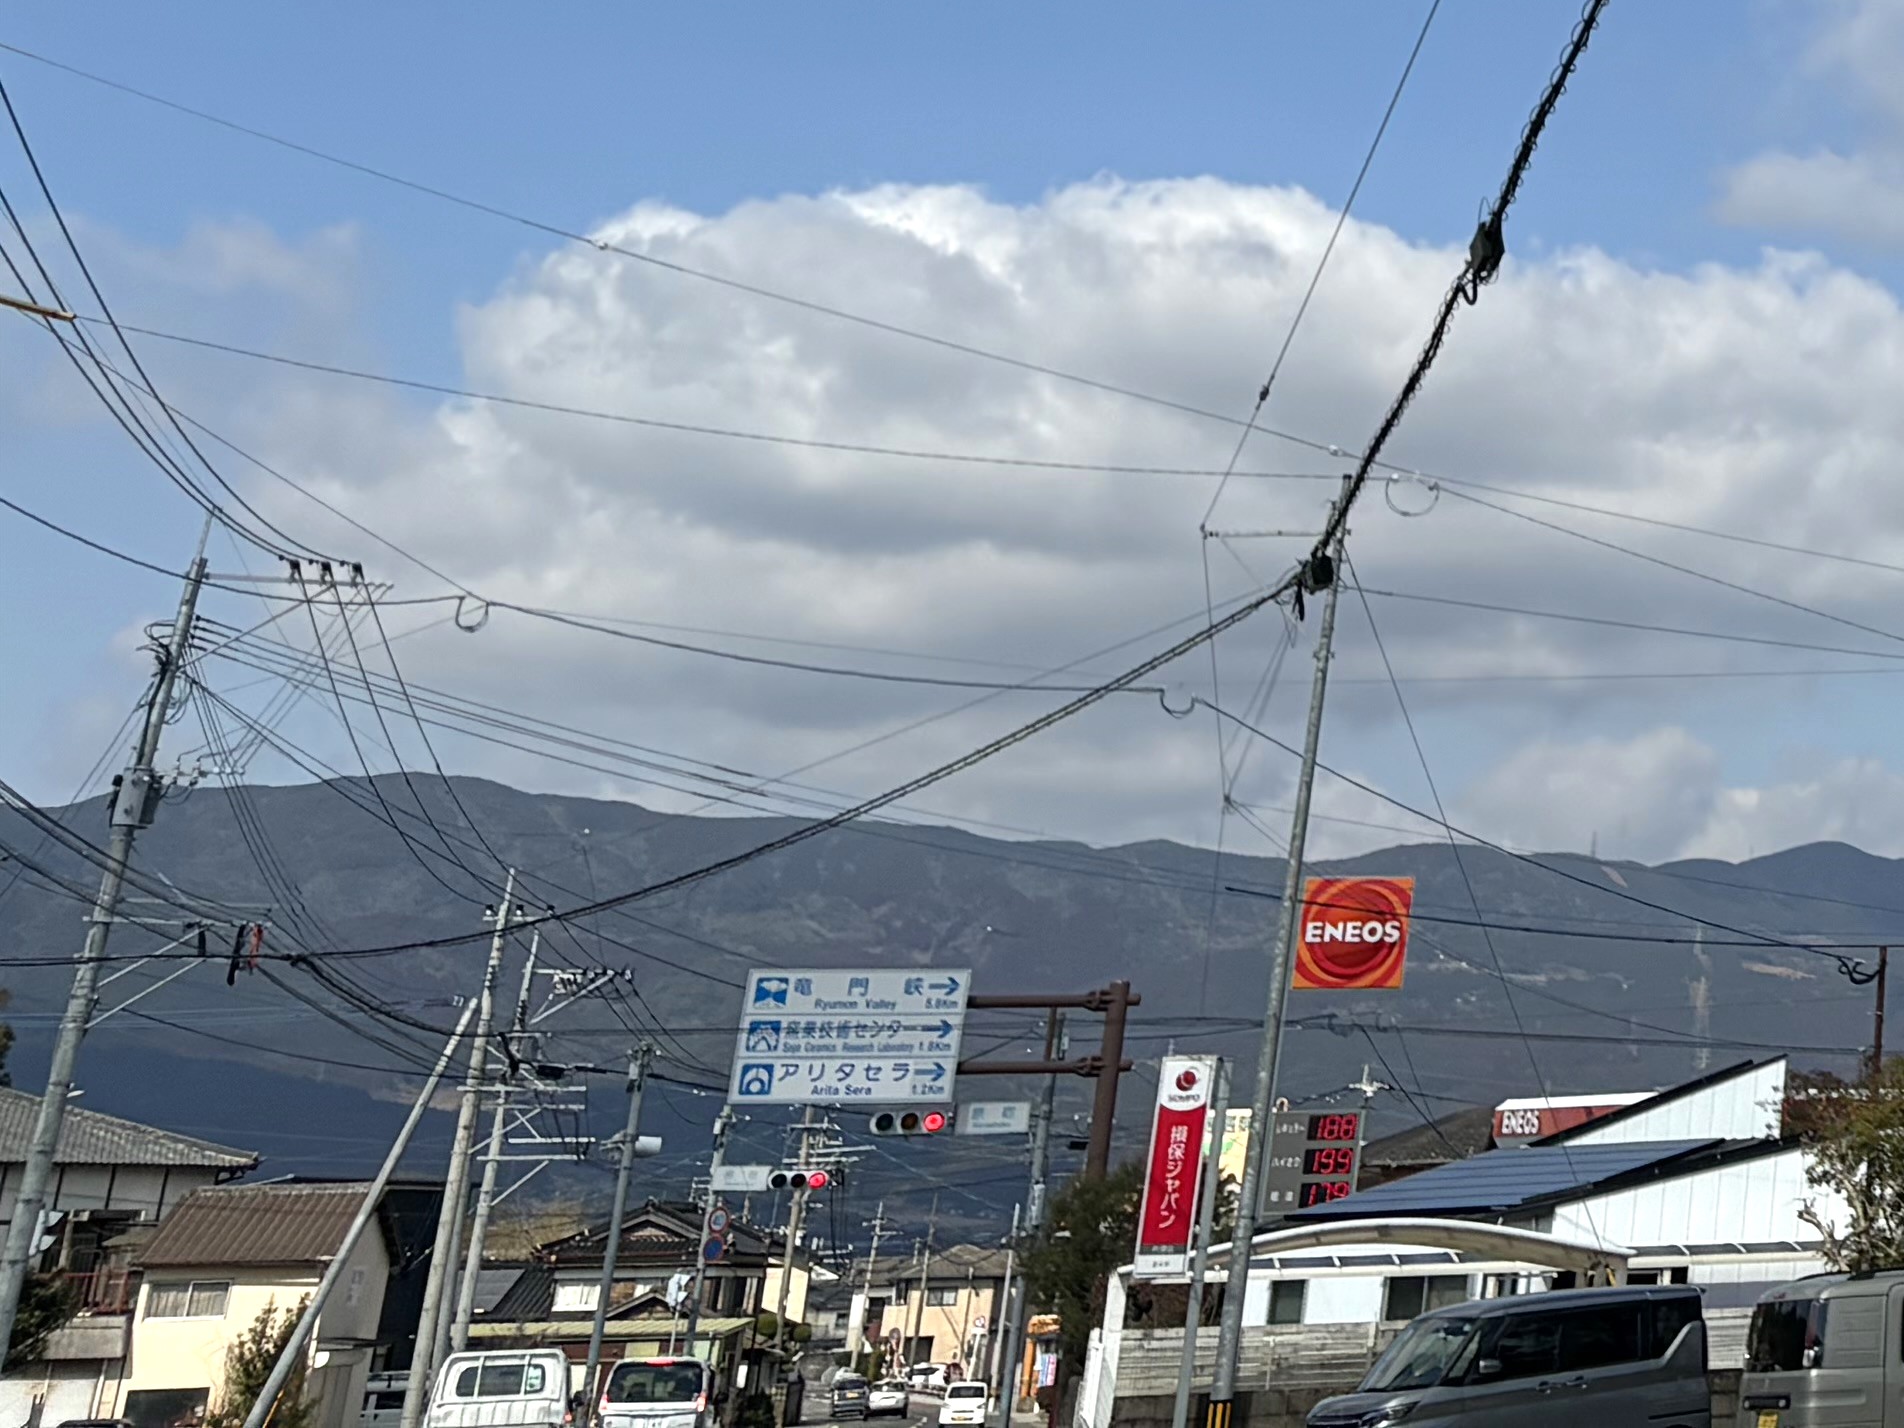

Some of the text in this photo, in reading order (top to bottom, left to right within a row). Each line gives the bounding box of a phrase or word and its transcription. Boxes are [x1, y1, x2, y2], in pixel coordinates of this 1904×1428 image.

[1304, 920, 1402, 944] ENEOS
[778, 1063, 911, 1082] アリタセラ
[1317, 1113, 1358, 1140] 188
[1501, 1110, 1540, 1134] ENEOS
[1313, 1148, 1354, 1174] 199
[1159, 1125, 1189, 1229] 損保ジャパン
